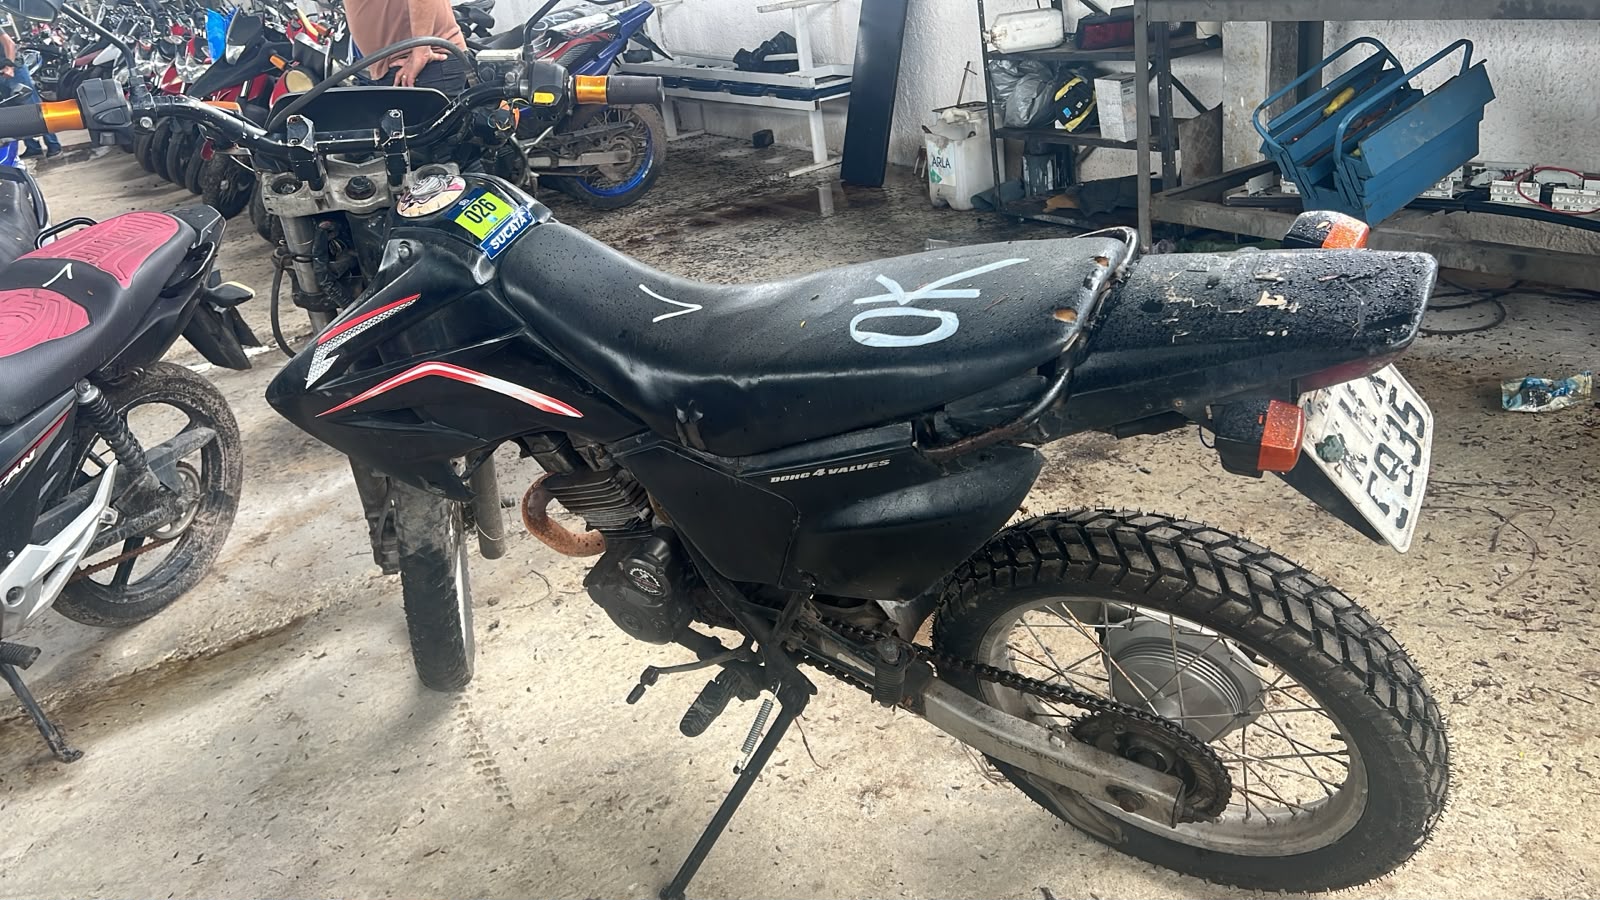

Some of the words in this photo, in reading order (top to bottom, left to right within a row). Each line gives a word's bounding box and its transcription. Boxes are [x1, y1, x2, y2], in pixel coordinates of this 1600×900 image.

[932, 156, 952, 170] ARLA
[463, 198, 497, 224] 026
[489, 211, 529, 250] SUCATA
[850, 258, 1030, 348] OK
[0, 447, 37, 488] TAN
[770, 472, 811, 483] DOHC
[812, 468, 827, 481] 4
[828, 460, 891, 475] VALVES
